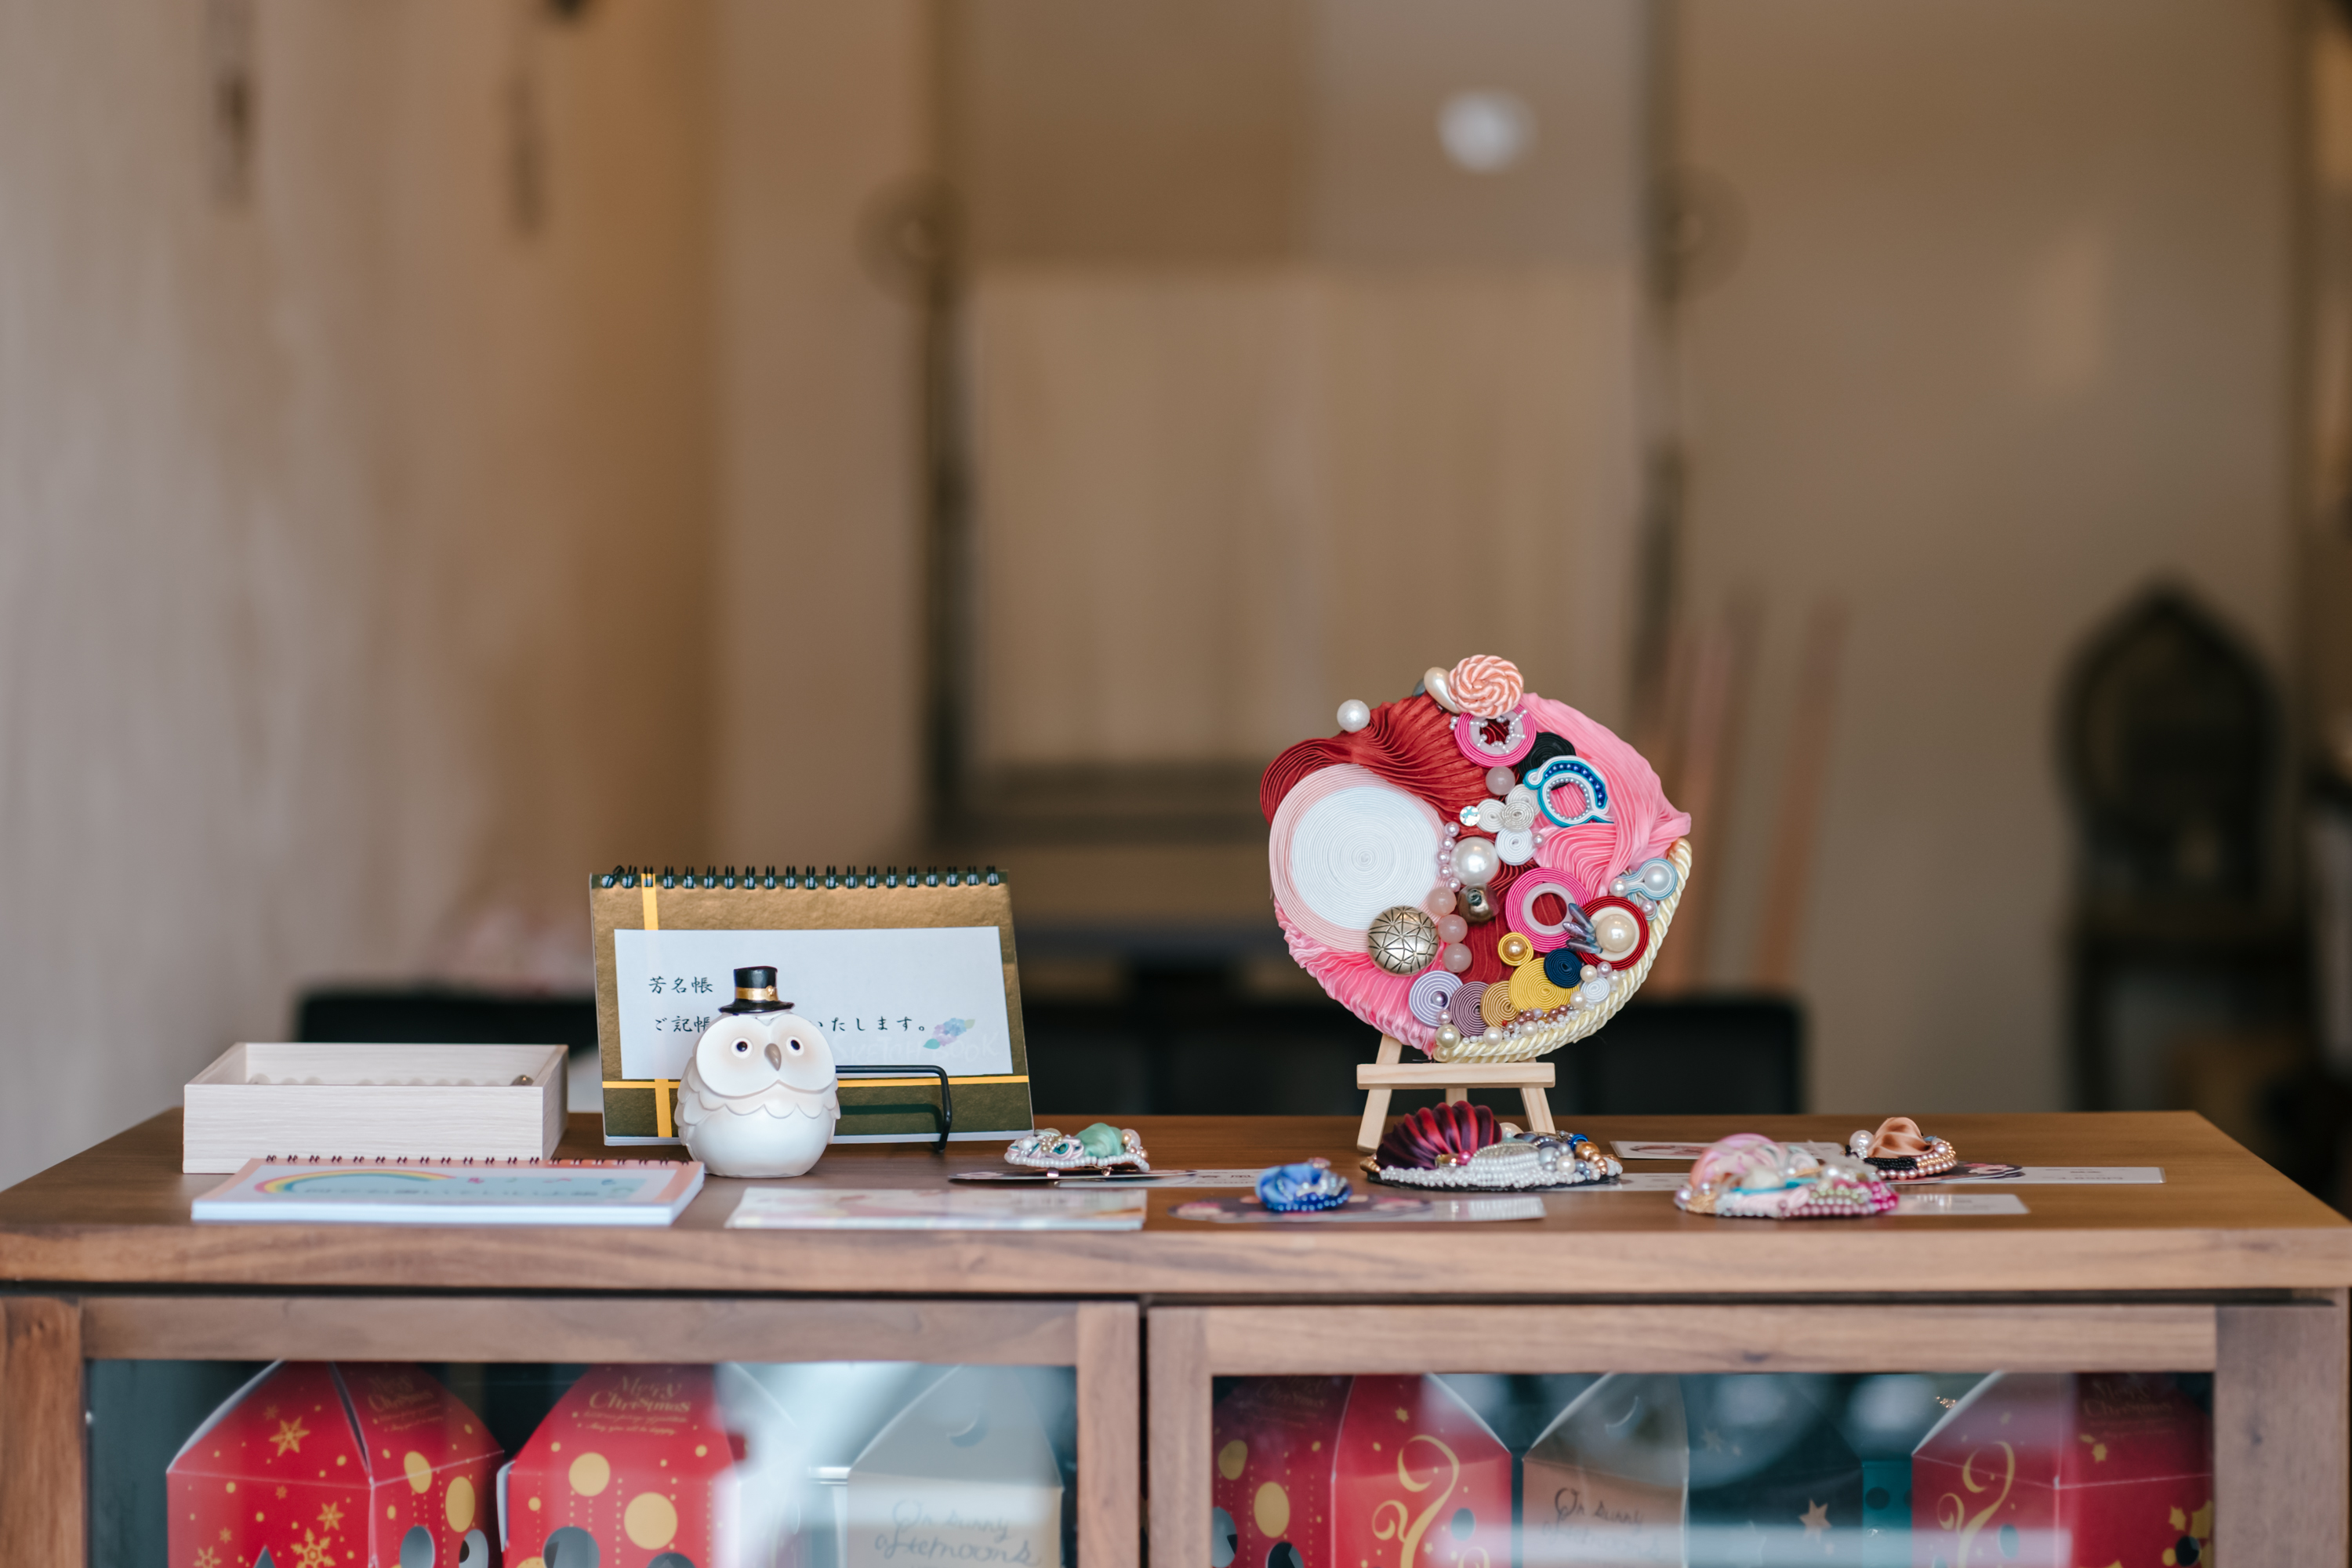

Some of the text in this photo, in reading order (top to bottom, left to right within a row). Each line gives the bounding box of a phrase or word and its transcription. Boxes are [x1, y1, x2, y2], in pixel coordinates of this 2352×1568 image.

[648, 975, 713, 994] 芳名帳
[612, 1374, 683, 1400] Merry
[588, 1390, 692, 1413] Christmas
[942, 1508, 1011, 1544] sunny
